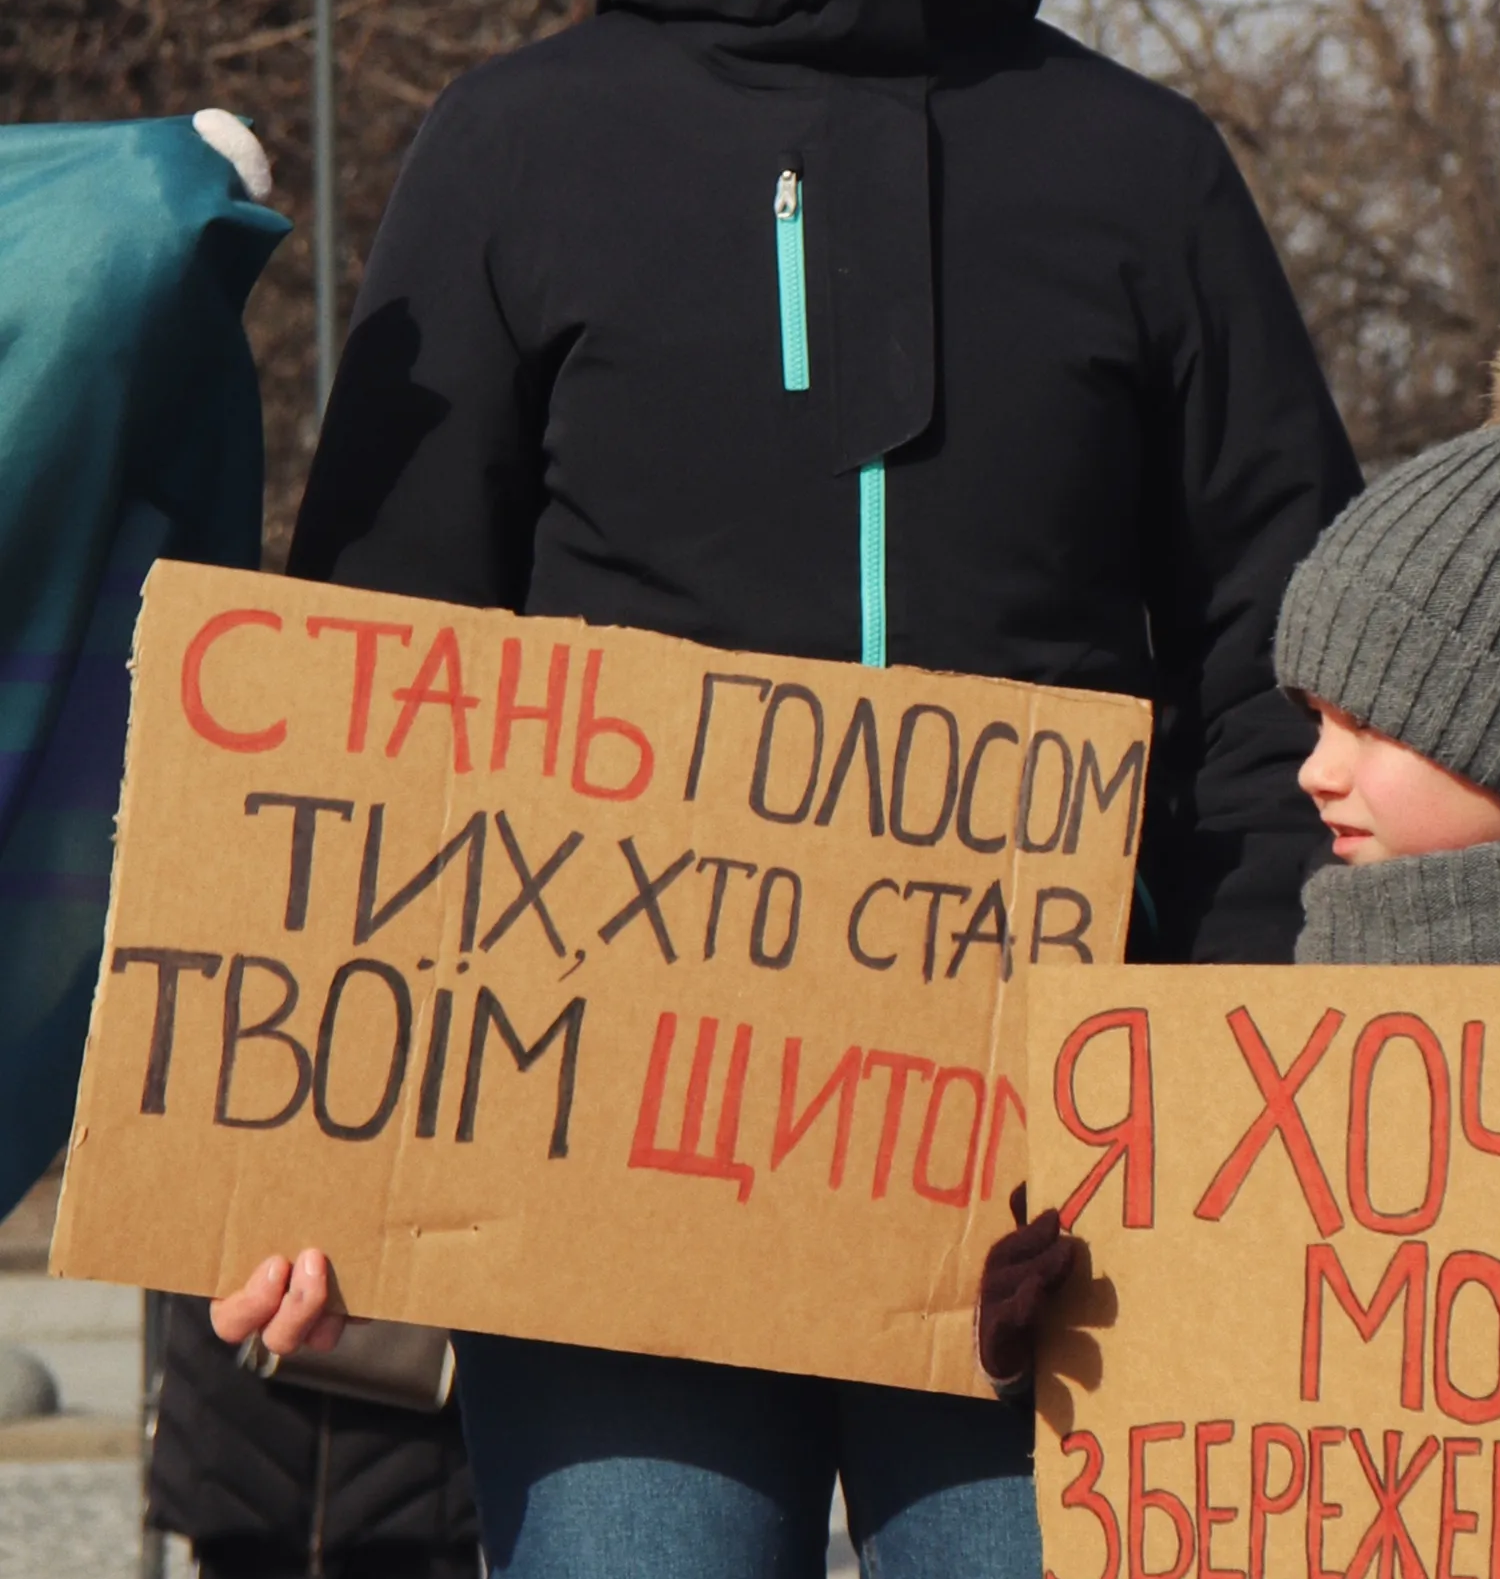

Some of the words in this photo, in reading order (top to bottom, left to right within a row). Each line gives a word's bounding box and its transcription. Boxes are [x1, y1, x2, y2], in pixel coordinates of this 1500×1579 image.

[179, 608, 655, 801] СТАНЬ
[683, 672, 1147, 858] ГОЛОСОМ
[243, 791, 586, 977] ТИХ,
[598, 834, 802, 971] ХТО
[846, 877, 1094, 984] СТАВ
[110, 946, 588, 1160] ТВОЇМ
[1053, 1006, 1155, 1232] Я
